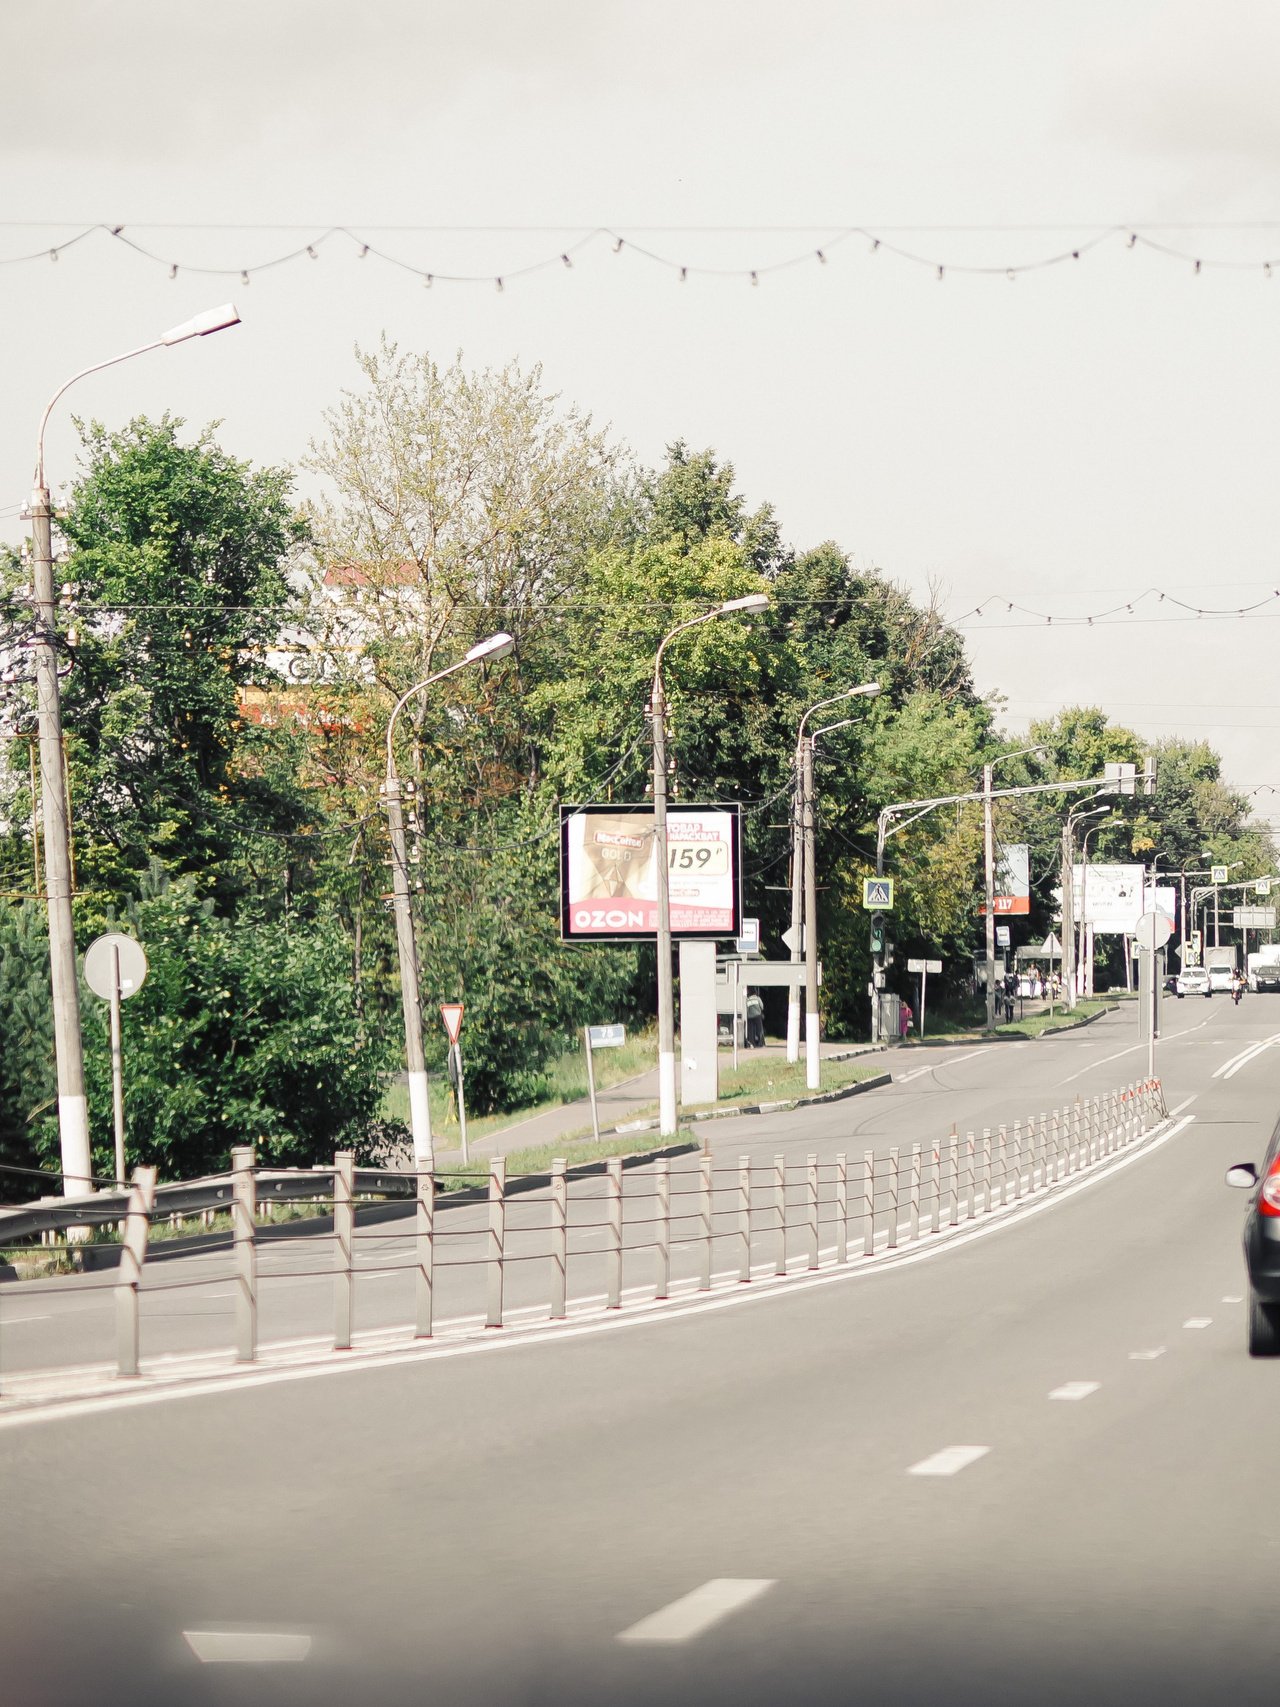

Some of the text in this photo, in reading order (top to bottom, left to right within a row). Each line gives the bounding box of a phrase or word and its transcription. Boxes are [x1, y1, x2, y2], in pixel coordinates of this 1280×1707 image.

[669, 848, 712, 868] 159
[998, 898, 1013, 910] 117
[575, 910, 644, 928] OZON
